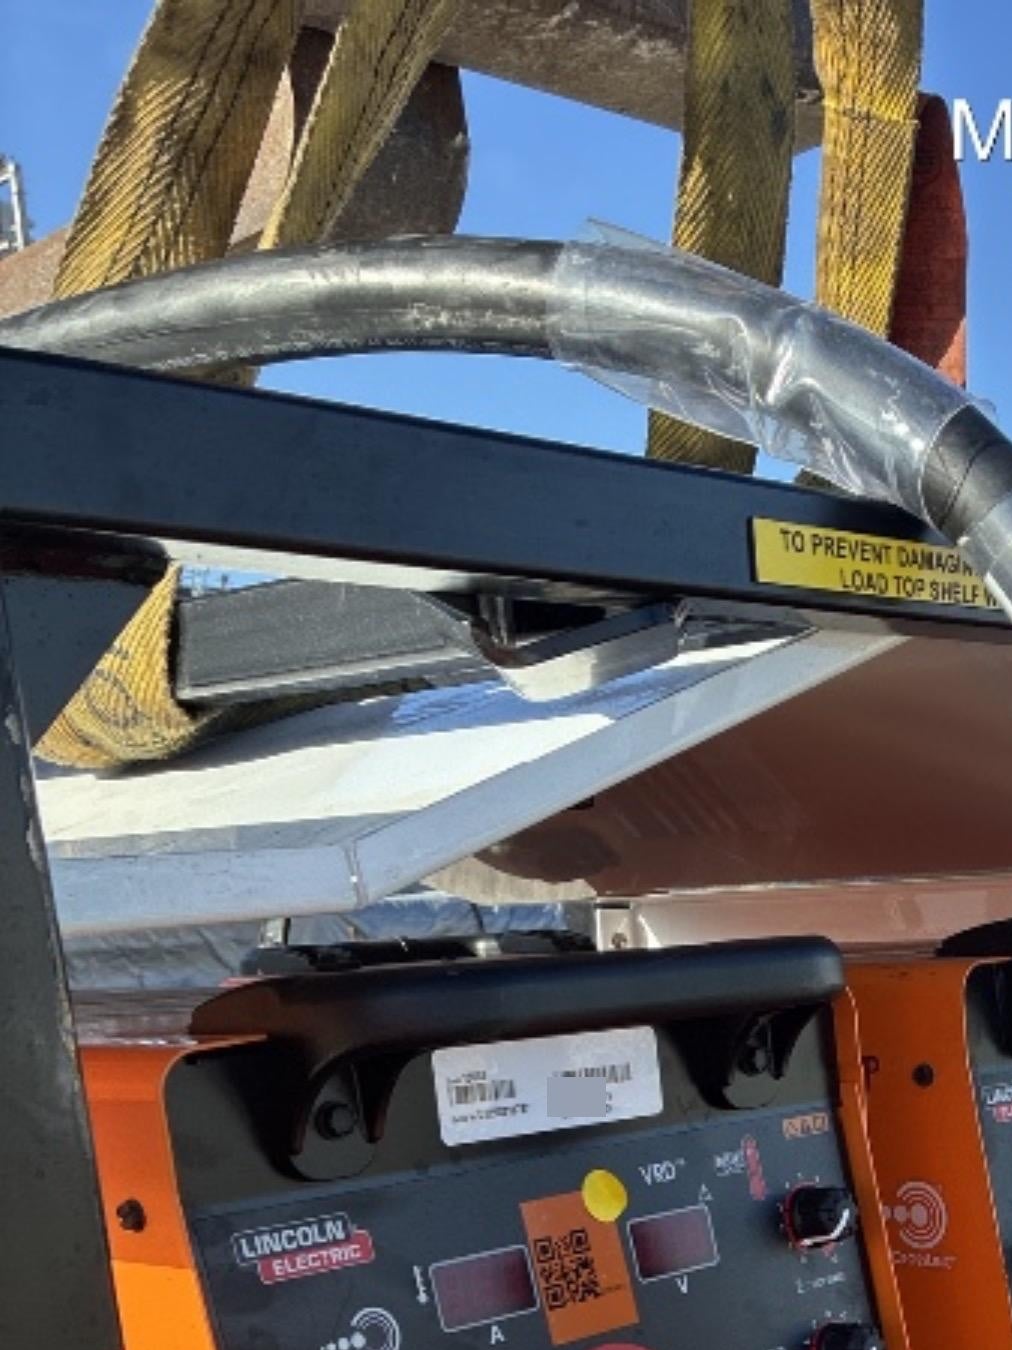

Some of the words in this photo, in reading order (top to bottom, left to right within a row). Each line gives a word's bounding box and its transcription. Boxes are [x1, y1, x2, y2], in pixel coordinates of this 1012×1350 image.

[780, 528, 804, 553] TO
[811, 533, 892, 565] PREVENT
[901, 546, 976, 578] DAMAGIN
[839, 567, 889, 592] LOAD
[893, 575, 925, 598] TOP
[239, 1219, 347, 1260] LINCOLN
[272, 1244, 362, 1277] ELECTRIC
